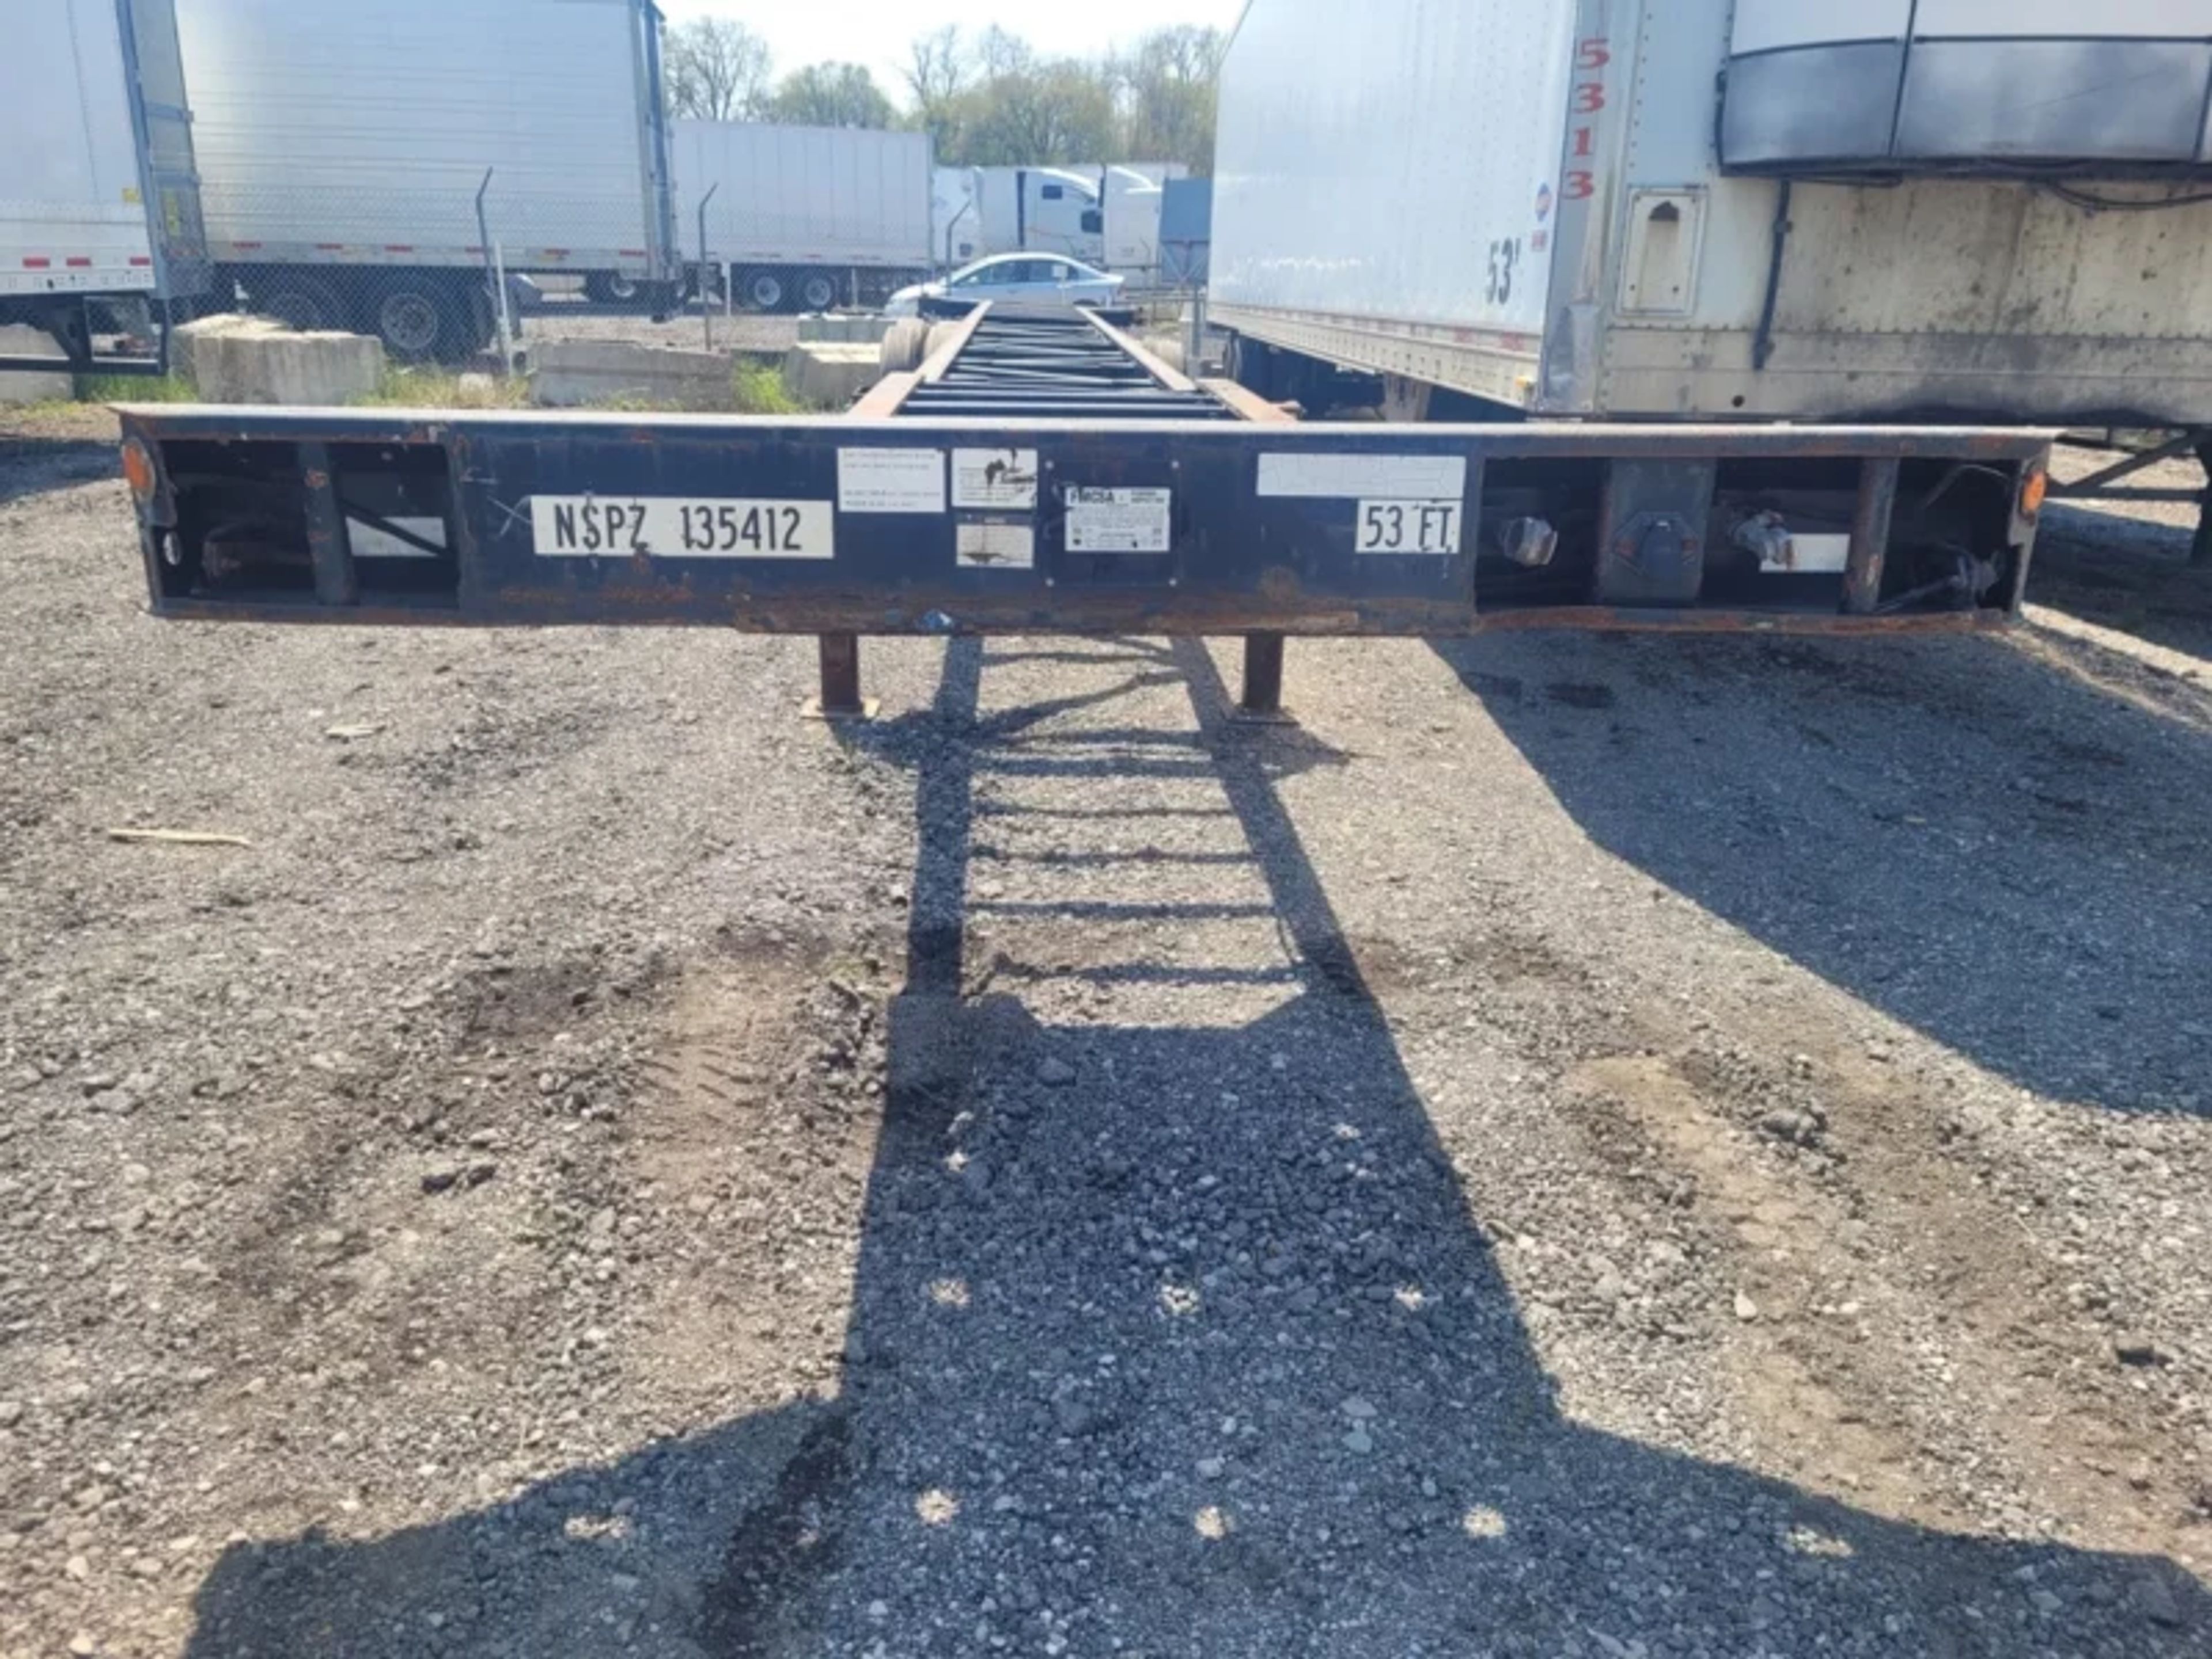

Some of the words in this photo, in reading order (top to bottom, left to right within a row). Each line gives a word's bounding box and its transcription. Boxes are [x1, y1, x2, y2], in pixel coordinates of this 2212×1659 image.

[554, 503, 647, 550] NSPZ
[679, 505, 801, 551] 135412
[1365, 505, 1403, 548] 53
[1418, 505, 1454, 548] FT
